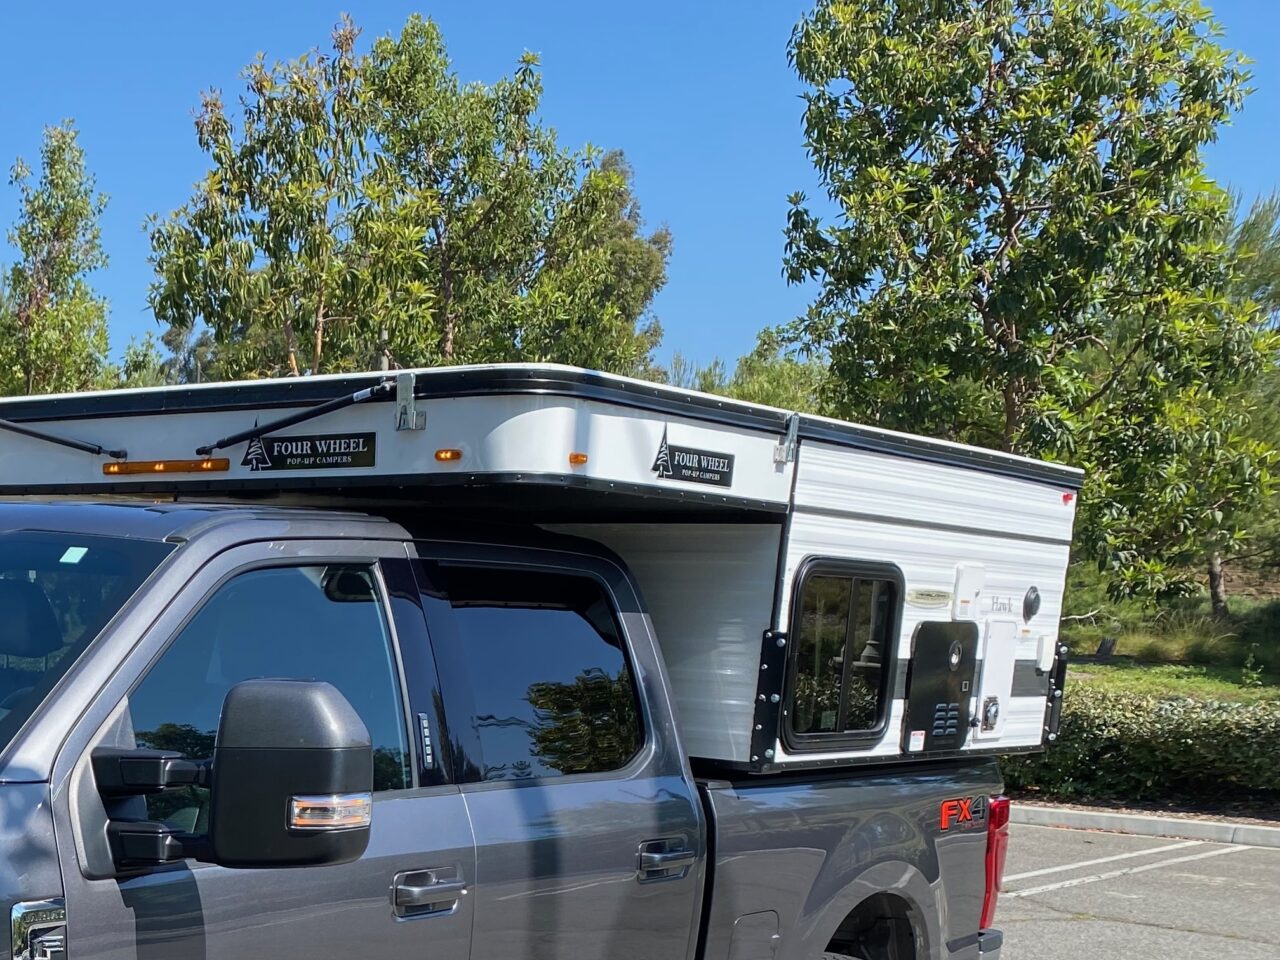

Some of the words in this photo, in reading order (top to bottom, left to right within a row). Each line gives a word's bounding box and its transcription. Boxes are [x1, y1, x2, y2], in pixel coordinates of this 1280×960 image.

[273, 441, 311, 456] FOUR
[315, 438, 368, 453] WHEEL
[286, 457, 315, 465] POP-UP
[316, 455, 352, 464] CAMPERS
[674, 452, 699, 467] FOUR
[700, 456, 729, 471] WHEEL
[681, 470, 699, 478] POP-UP
[700, 472, 720, 480] CAMPERS
[991, 595, 1014, 613] Hawk
[940, 794, 986, 832] FX4
[24, 910, 65, 924] LARIAT
